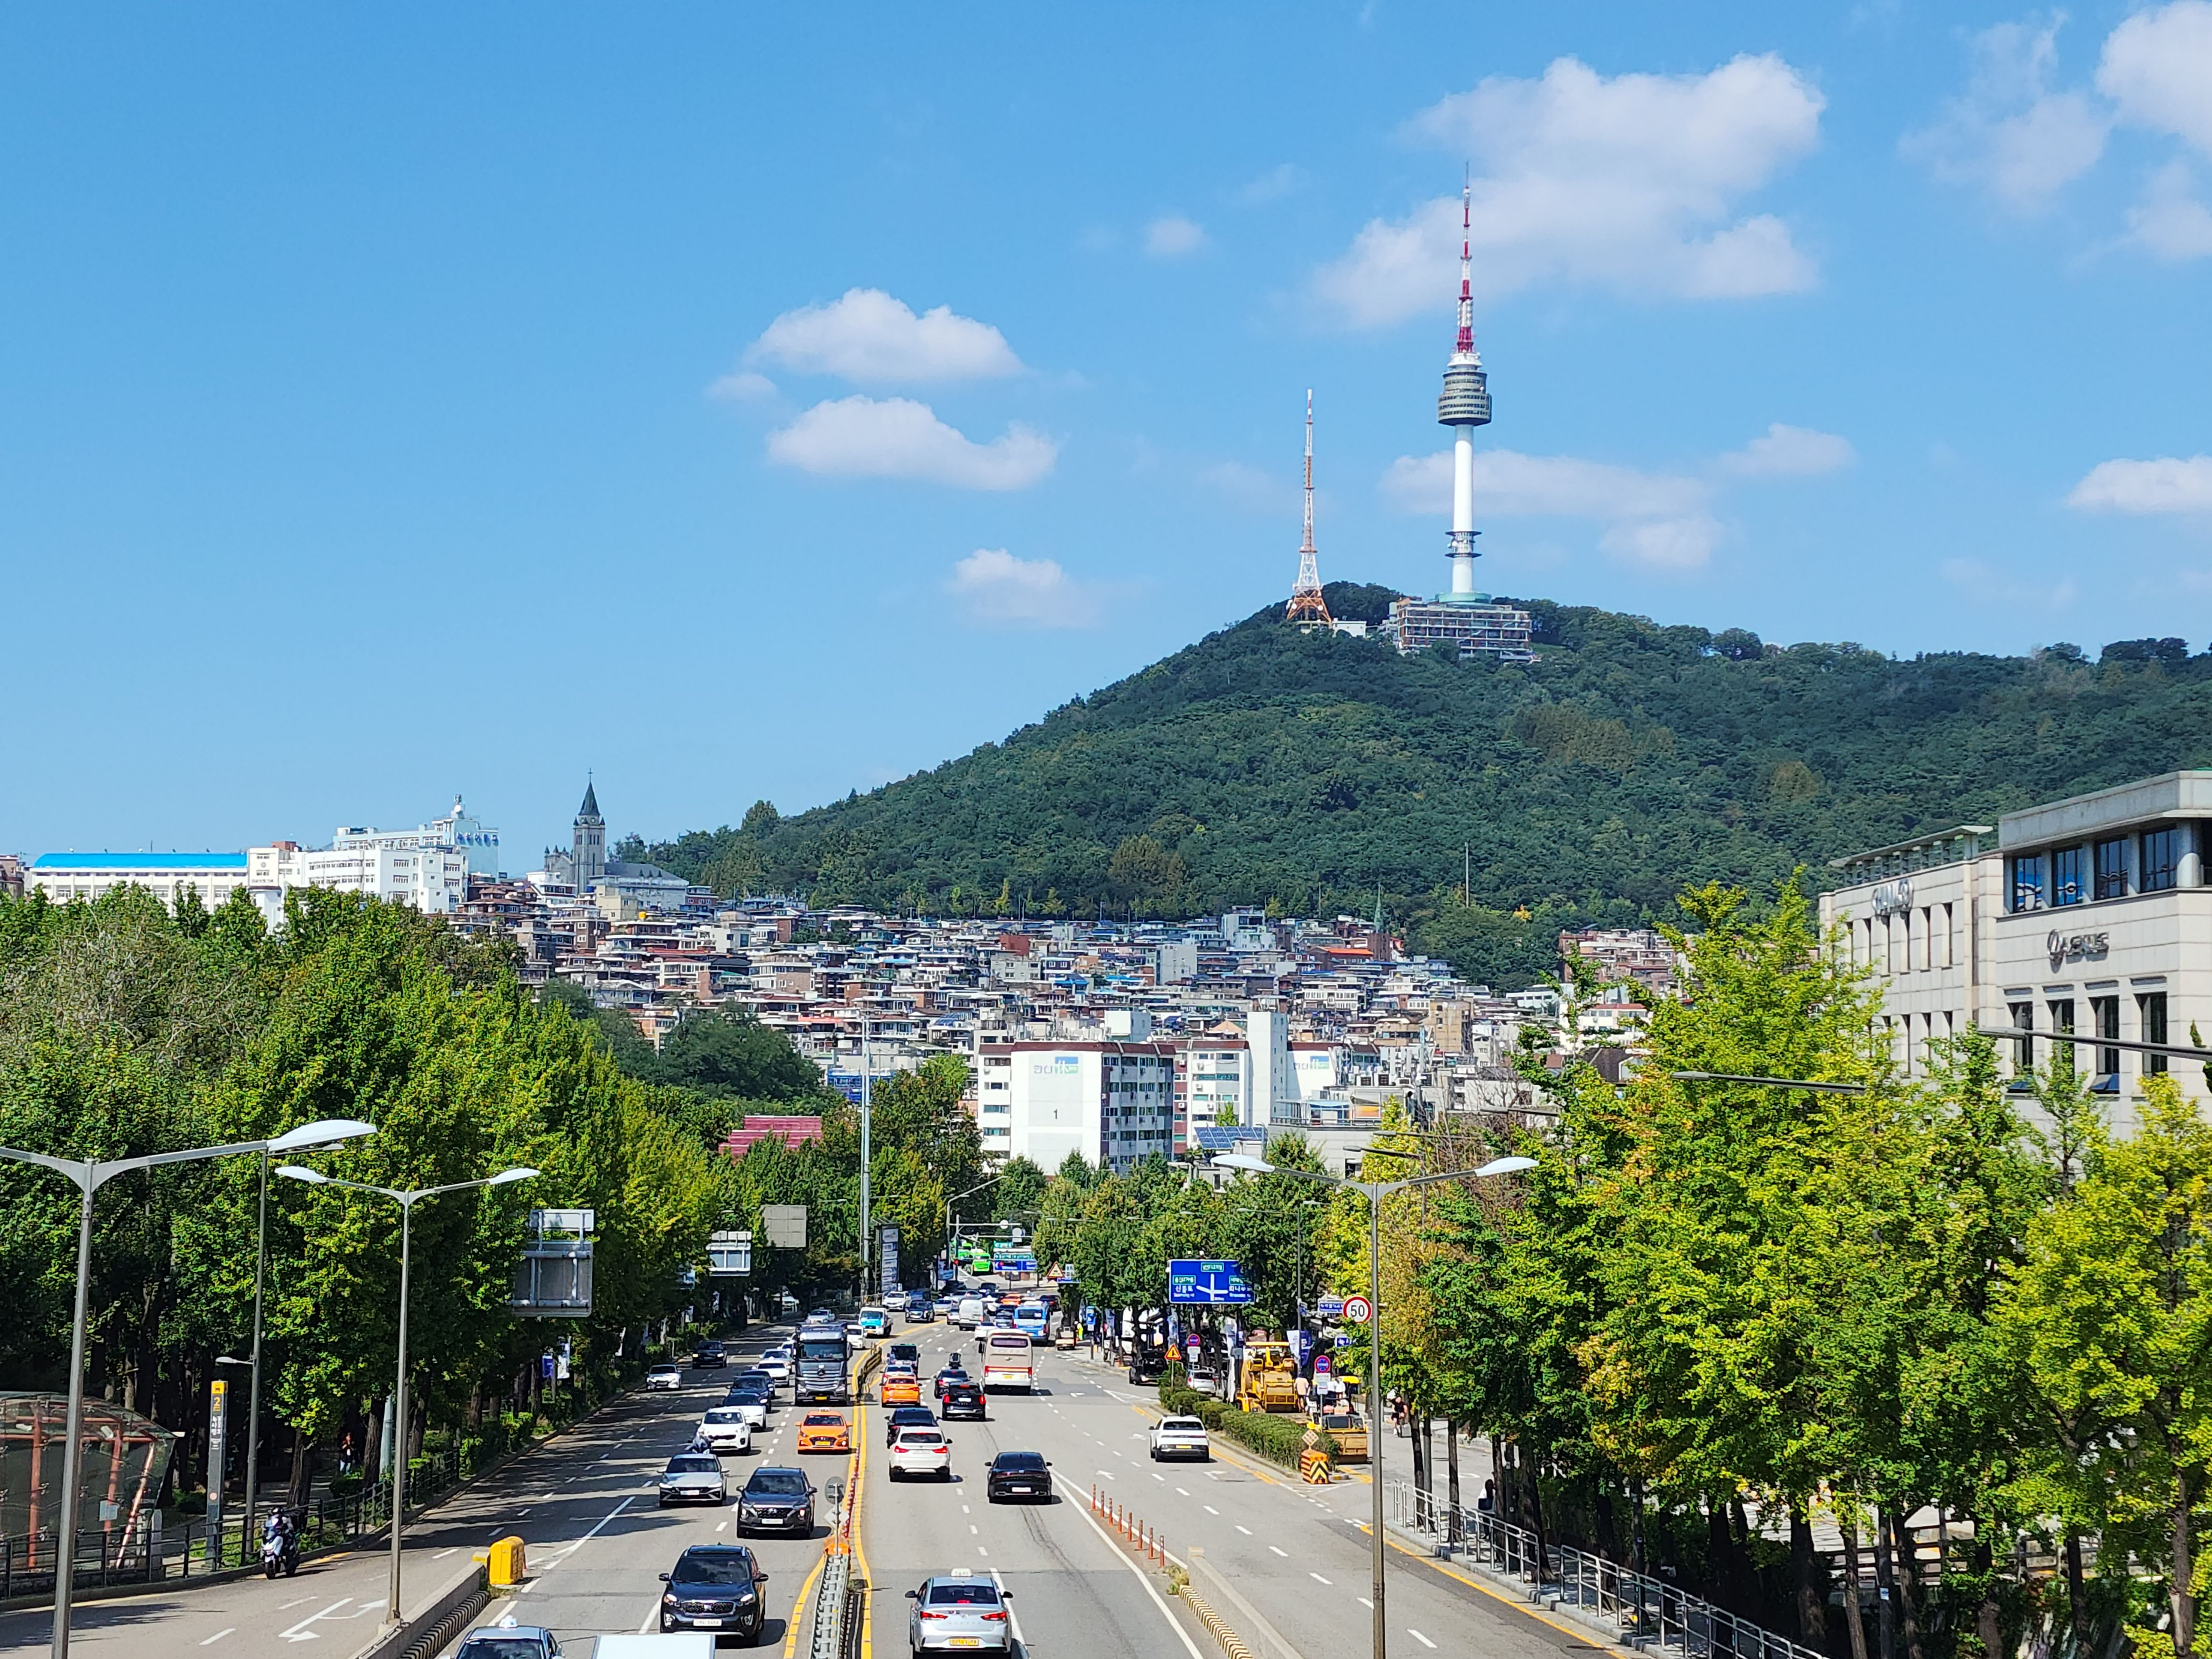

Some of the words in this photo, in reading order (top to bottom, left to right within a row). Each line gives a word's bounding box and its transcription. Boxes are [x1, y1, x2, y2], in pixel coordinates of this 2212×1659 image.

[1053, 1108, 1058, 1119] 1
[1350, 1304, 1365, 1317] 50
[214, 1397, 220, 1406] 2
